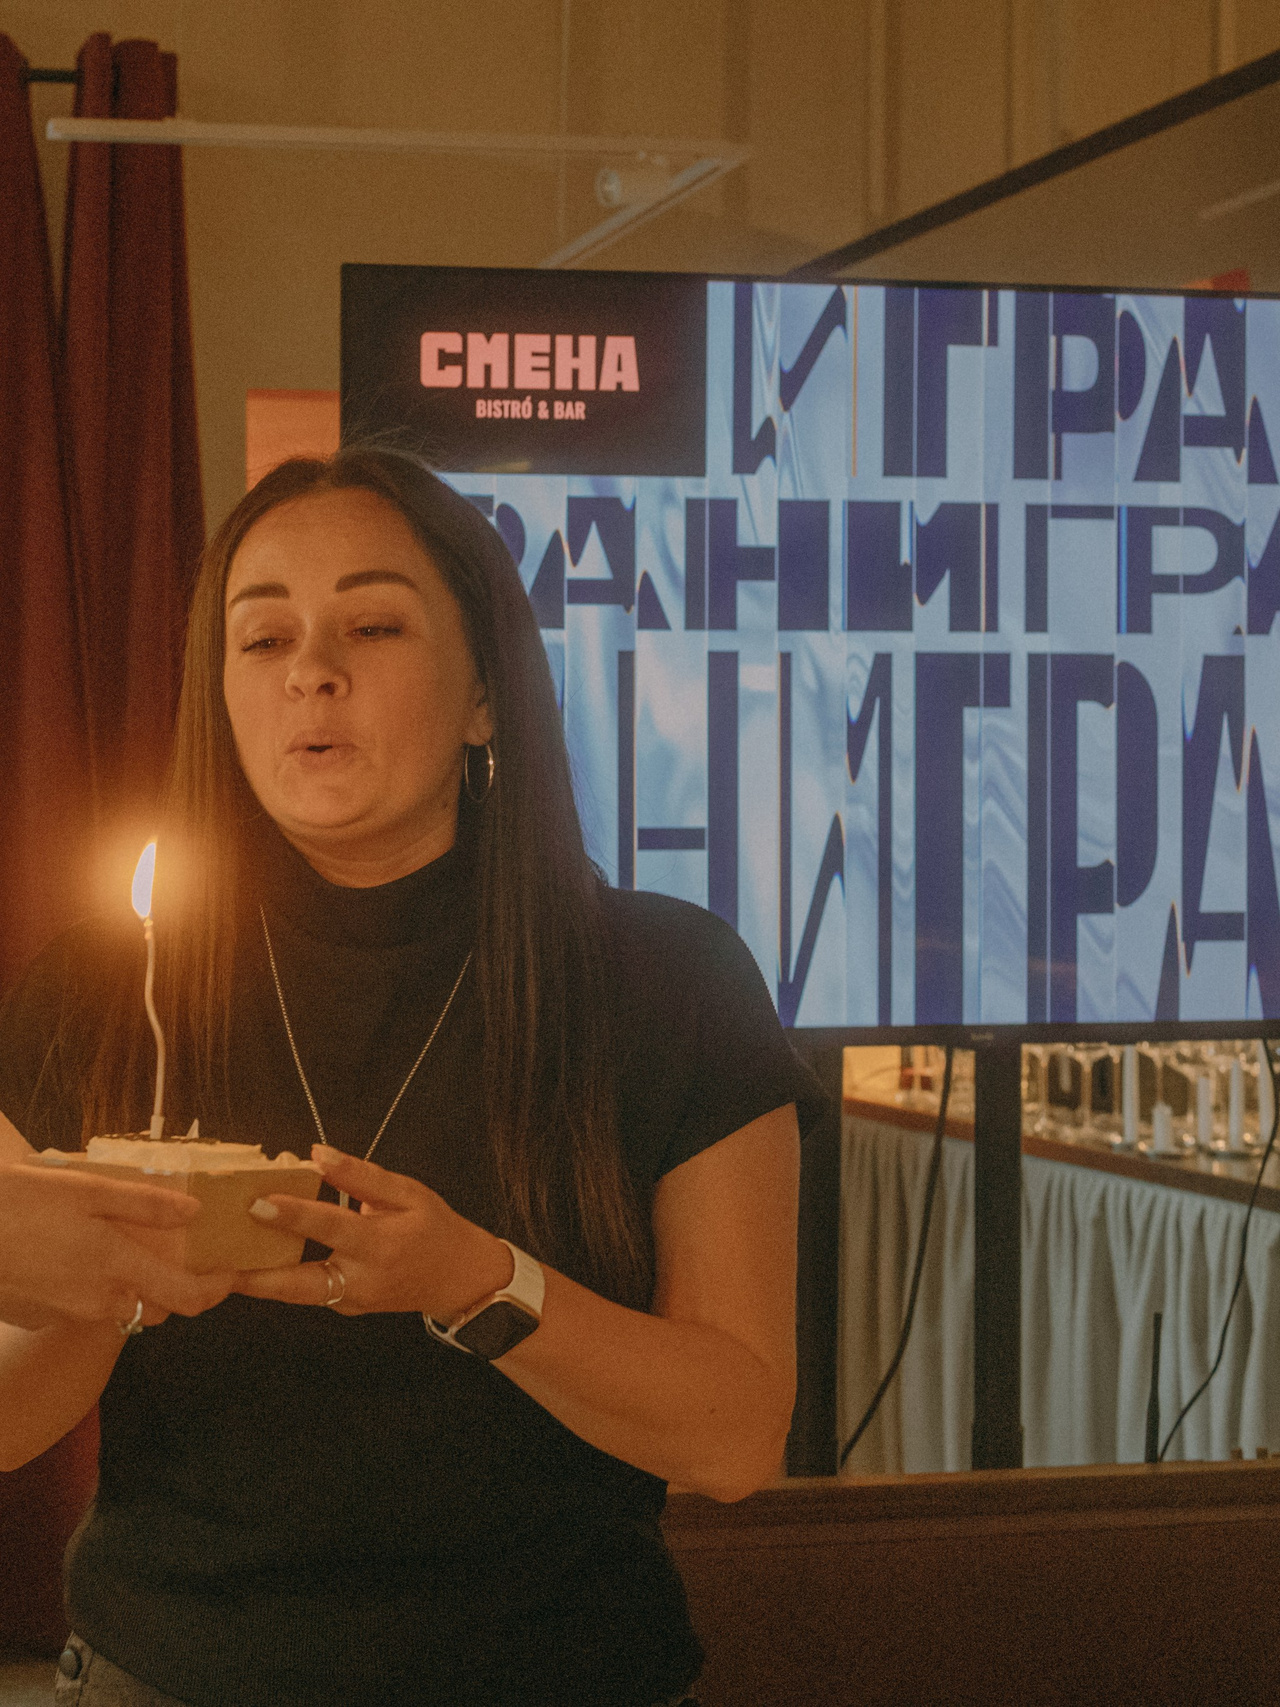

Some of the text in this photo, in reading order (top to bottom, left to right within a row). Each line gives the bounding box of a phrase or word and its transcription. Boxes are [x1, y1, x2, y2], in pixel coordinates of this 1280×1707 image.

[420, 331, 640, 392] СМЕНА
[475, 395, 586, 420] BISTRÓ & BAR
